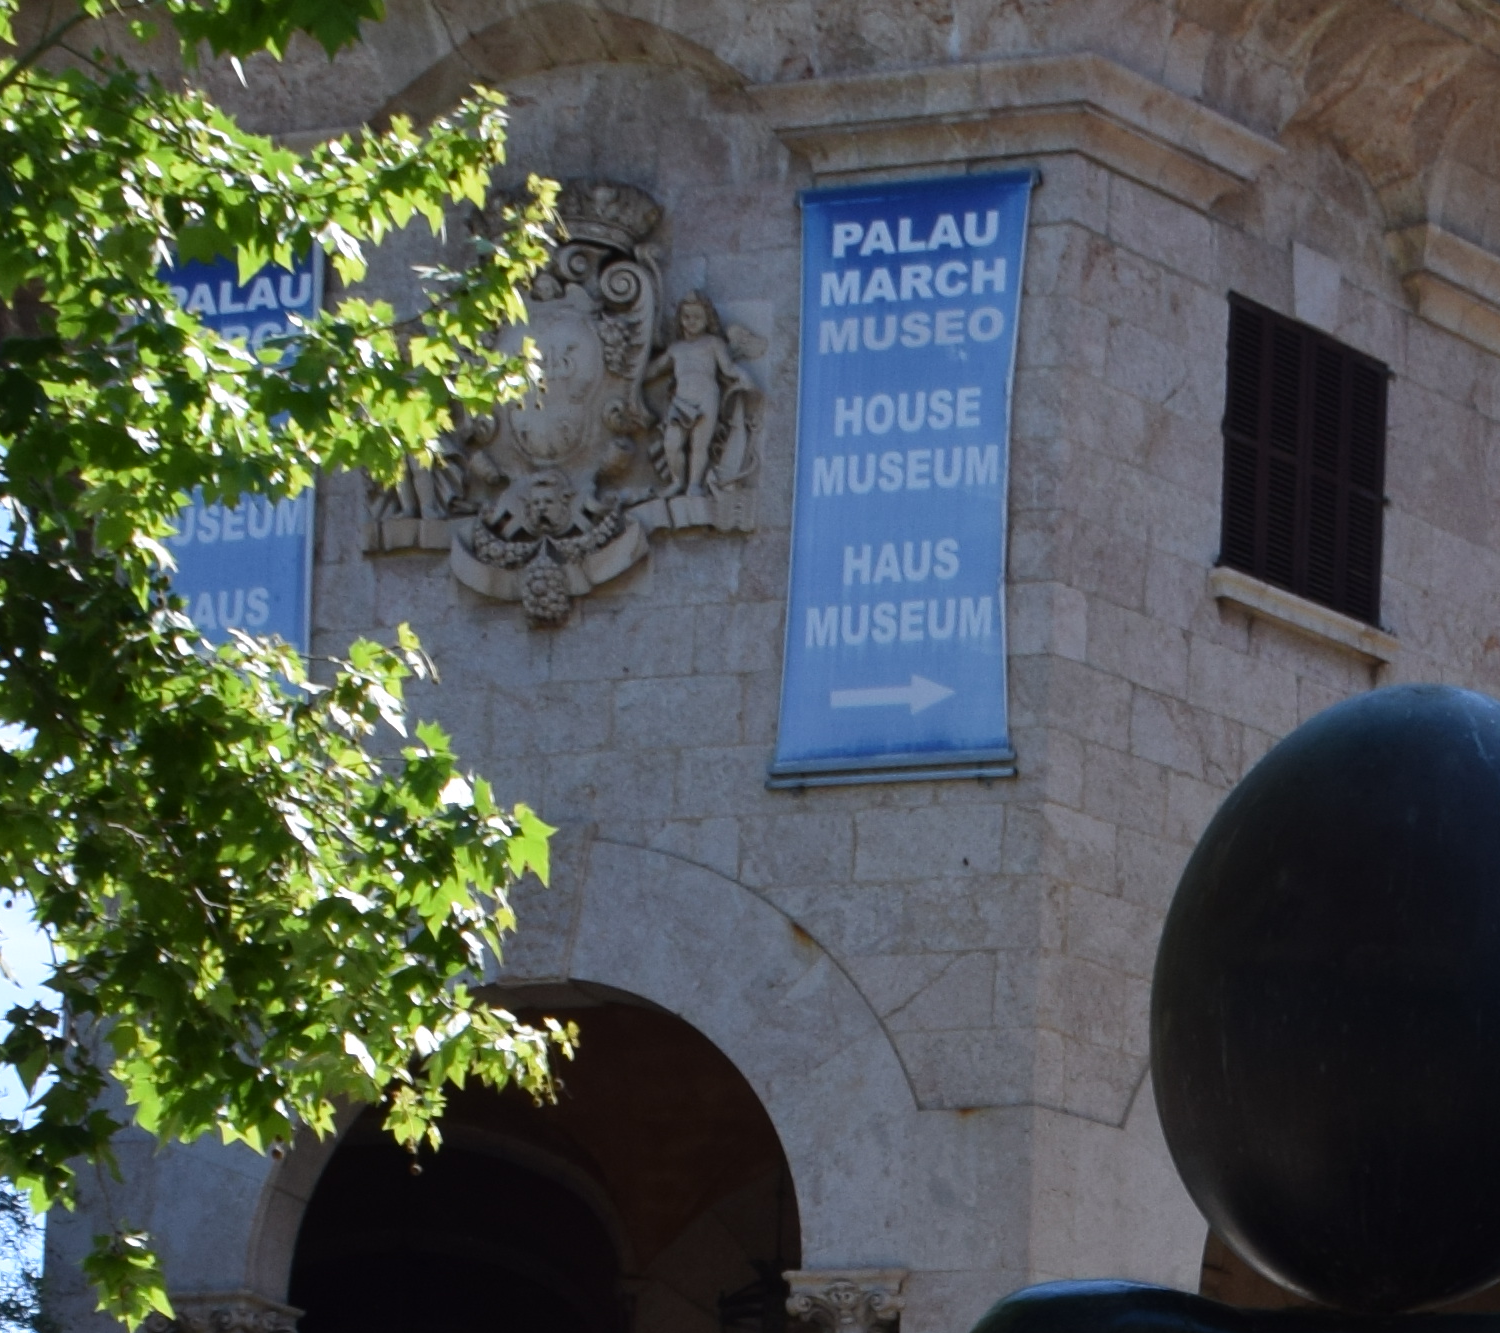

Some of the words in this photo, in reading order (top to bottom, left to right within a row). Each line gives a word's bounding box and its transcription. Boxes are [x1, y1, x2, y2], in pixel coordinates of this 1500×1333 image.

[832, 210, 999, 258] PALAU
[820, 257, 1007, 307] MARCH
[819, 306, 1005, 355] MUSEO
[834, 386, 982, 437] HOUSE
[812, 444, 999, 498] MUSEUM
[165, 496, 305, 547] USEUM
[842, 537, 960, 586] HAUS
[184, 586, 269, 630] AUS
[805, 596, 993, 649] MUSEUM
